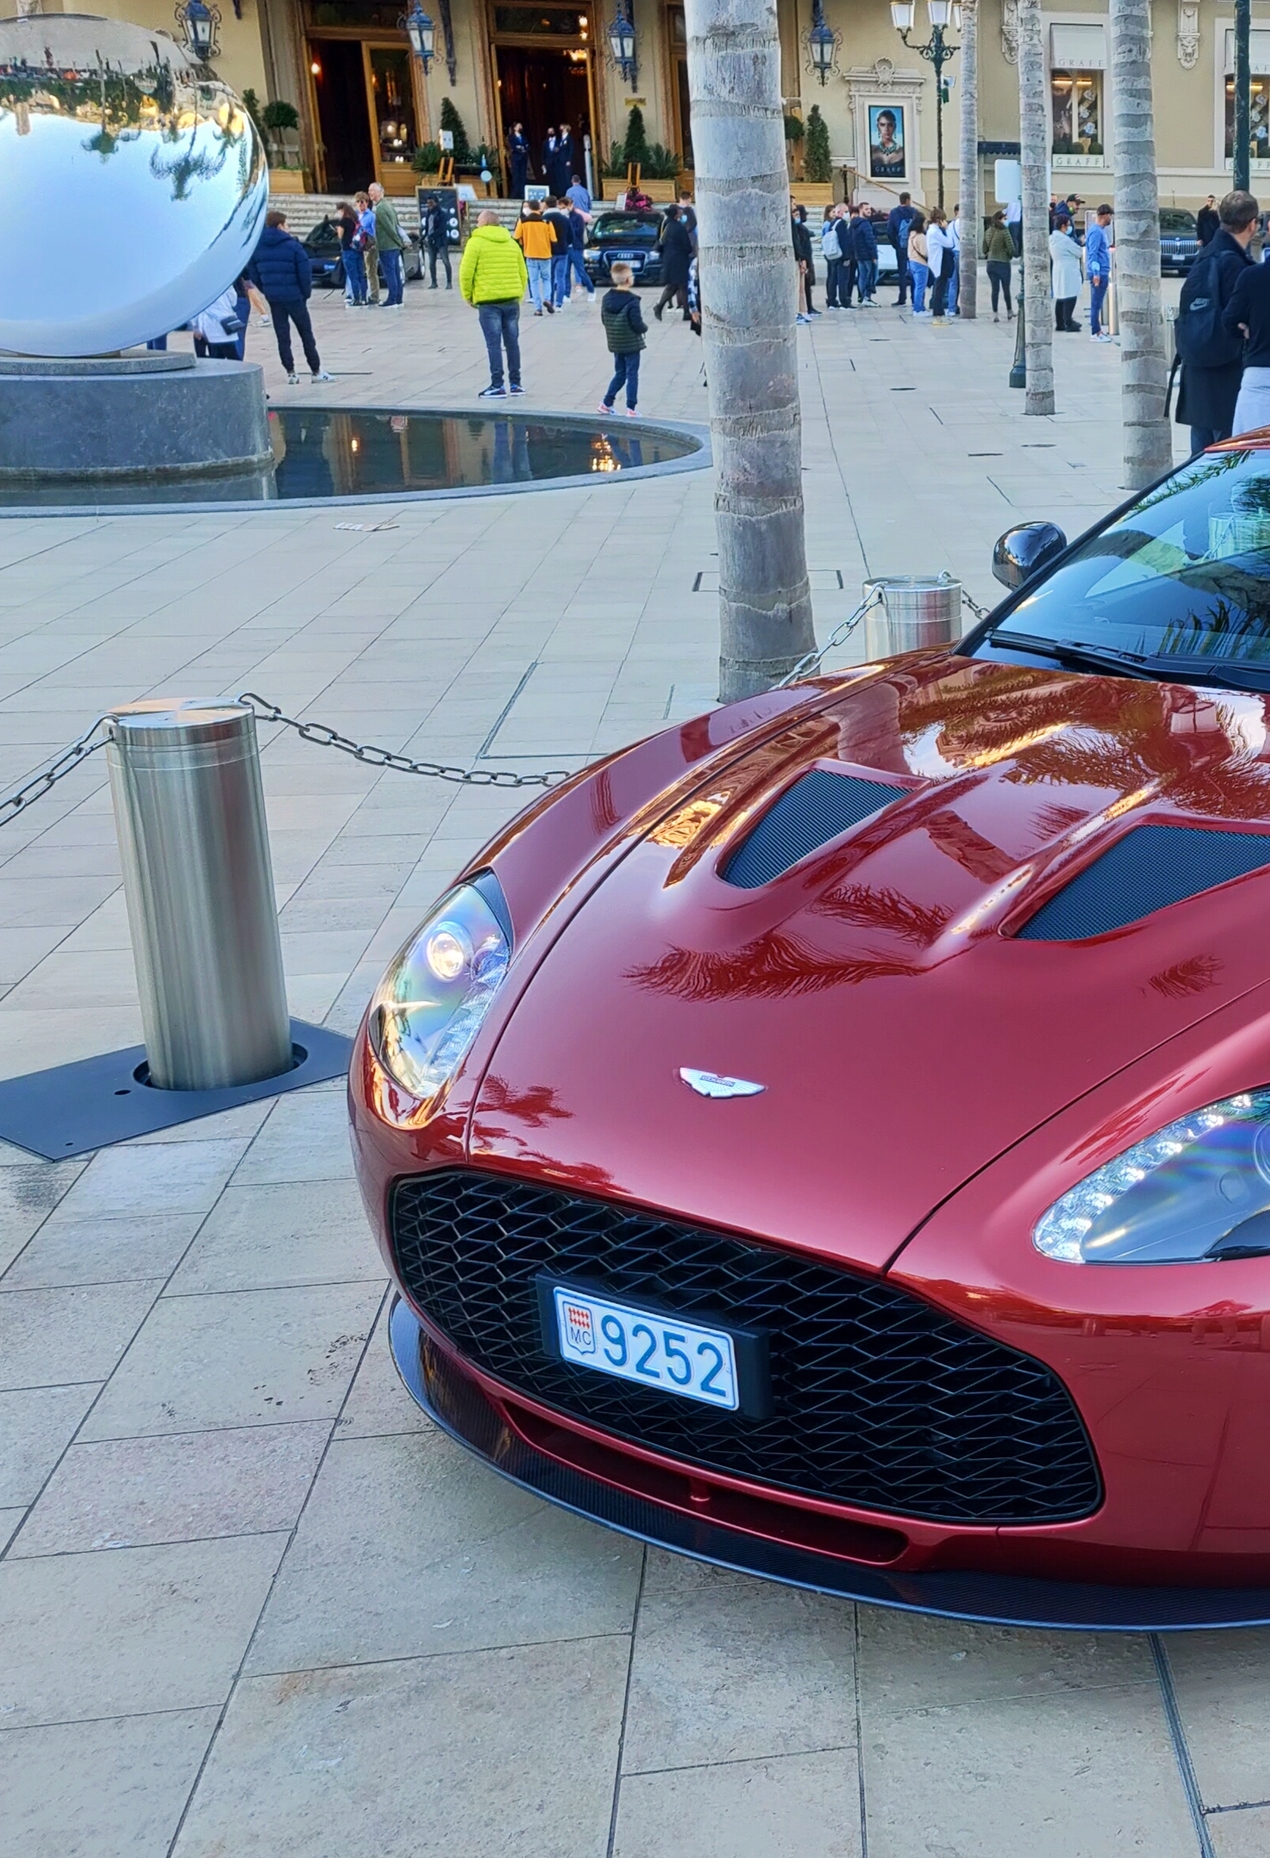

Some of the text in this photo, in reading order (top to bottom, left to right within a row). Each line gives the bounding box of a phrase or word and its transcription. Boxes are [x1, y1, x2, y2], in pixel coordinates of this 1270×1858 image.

[1058, 58, 1103, 67] GRAFF
[1056, 157, 1101, 166] GRAFF
[570, 1314, 727, 1397] MC 9252
